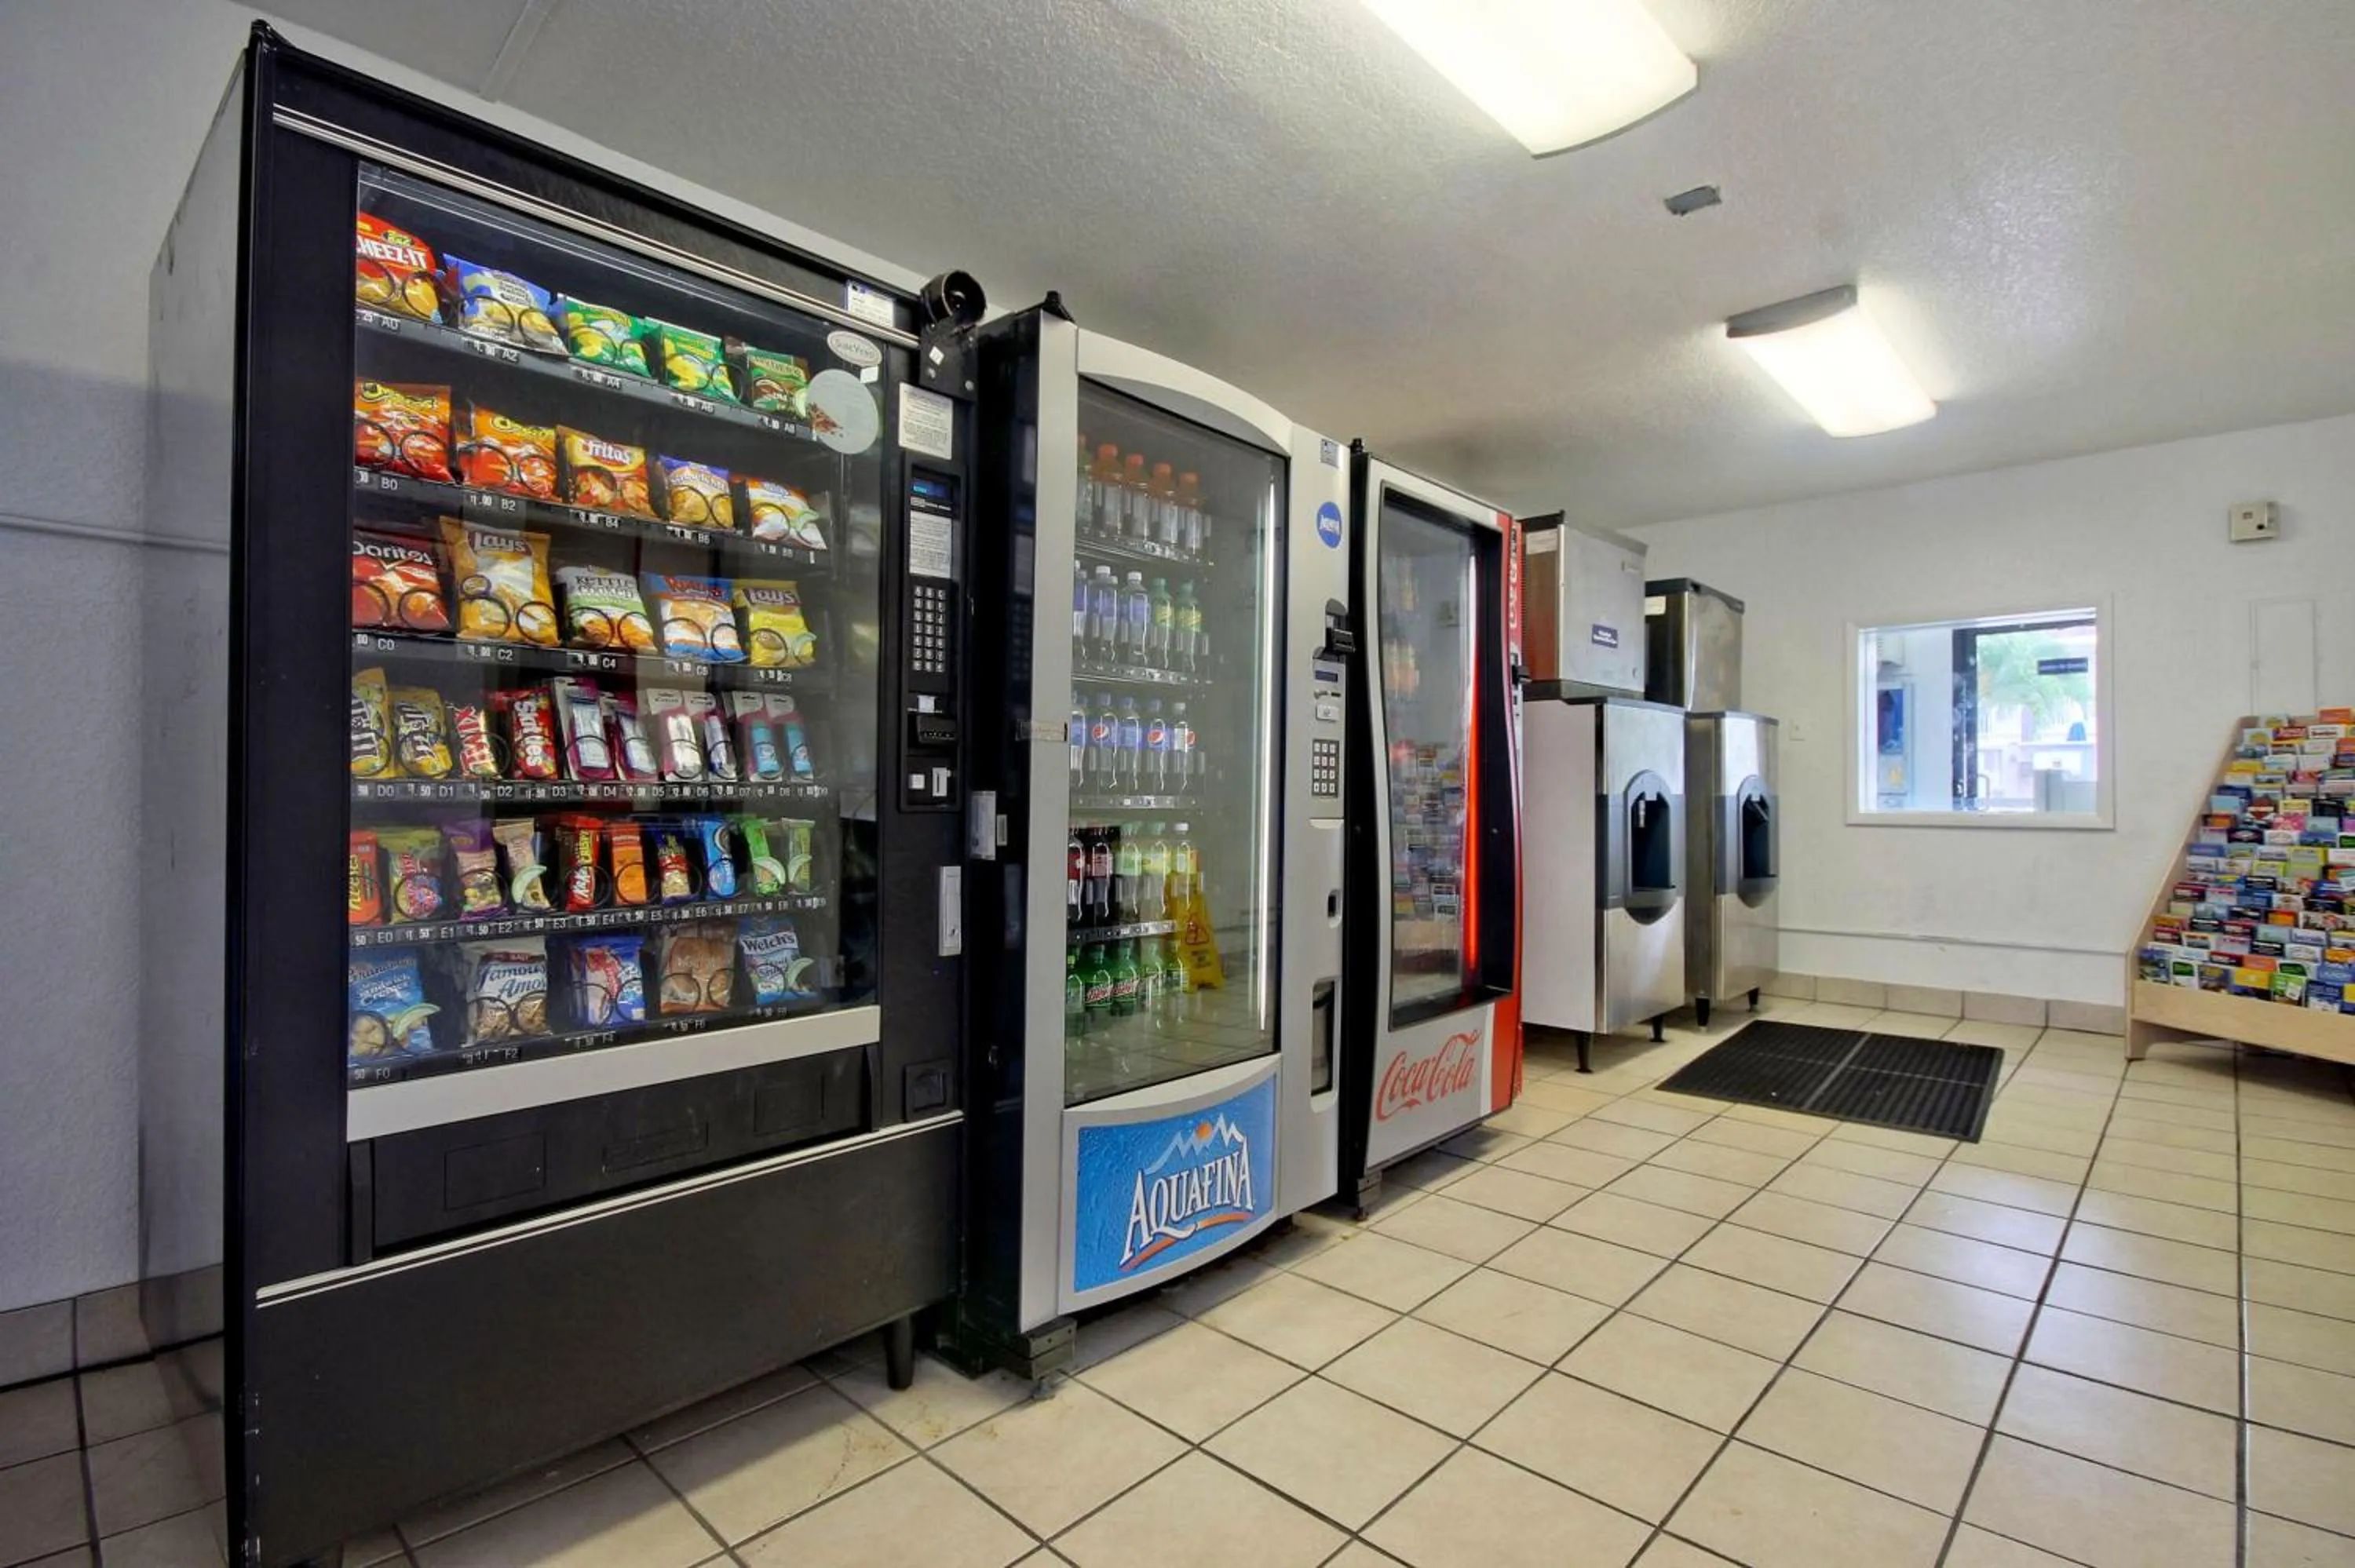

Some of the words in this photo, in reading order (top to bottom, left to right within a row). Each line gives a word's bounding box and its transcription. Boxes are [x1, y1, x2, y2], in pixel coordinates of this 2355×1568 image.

[381, 477, 398, 490] B0
[502, 498, 517, 511] B2
[378, 638, 395, 651] C0
[498, 648, 513, 661] C2
[602, 658, 616, 669] C4
[377, 784, 395, 797] D0
[439, 785, 454, 798] D1
[497, 785, 513, 798] D2
[552, 786, 566, 797] D3
[604, 786, 617, 797] D4
[651, 910, 663, 921] E5
[695, 906, 707, 917] E6
[553, 918, 566, 930] E3
[602, 913, 615, 925] E4
[440, 926, 454, 939] E1
[498, 922, 513, 934] E2
[378, 931, 393, 943] E0
[742, 931, 797, 953] Welch's
[505, 1048, 520, 1059] F2
[376, 1067, 391, 1080] F0
[1119, 1135, 1254, 1267] AQUAFINA
